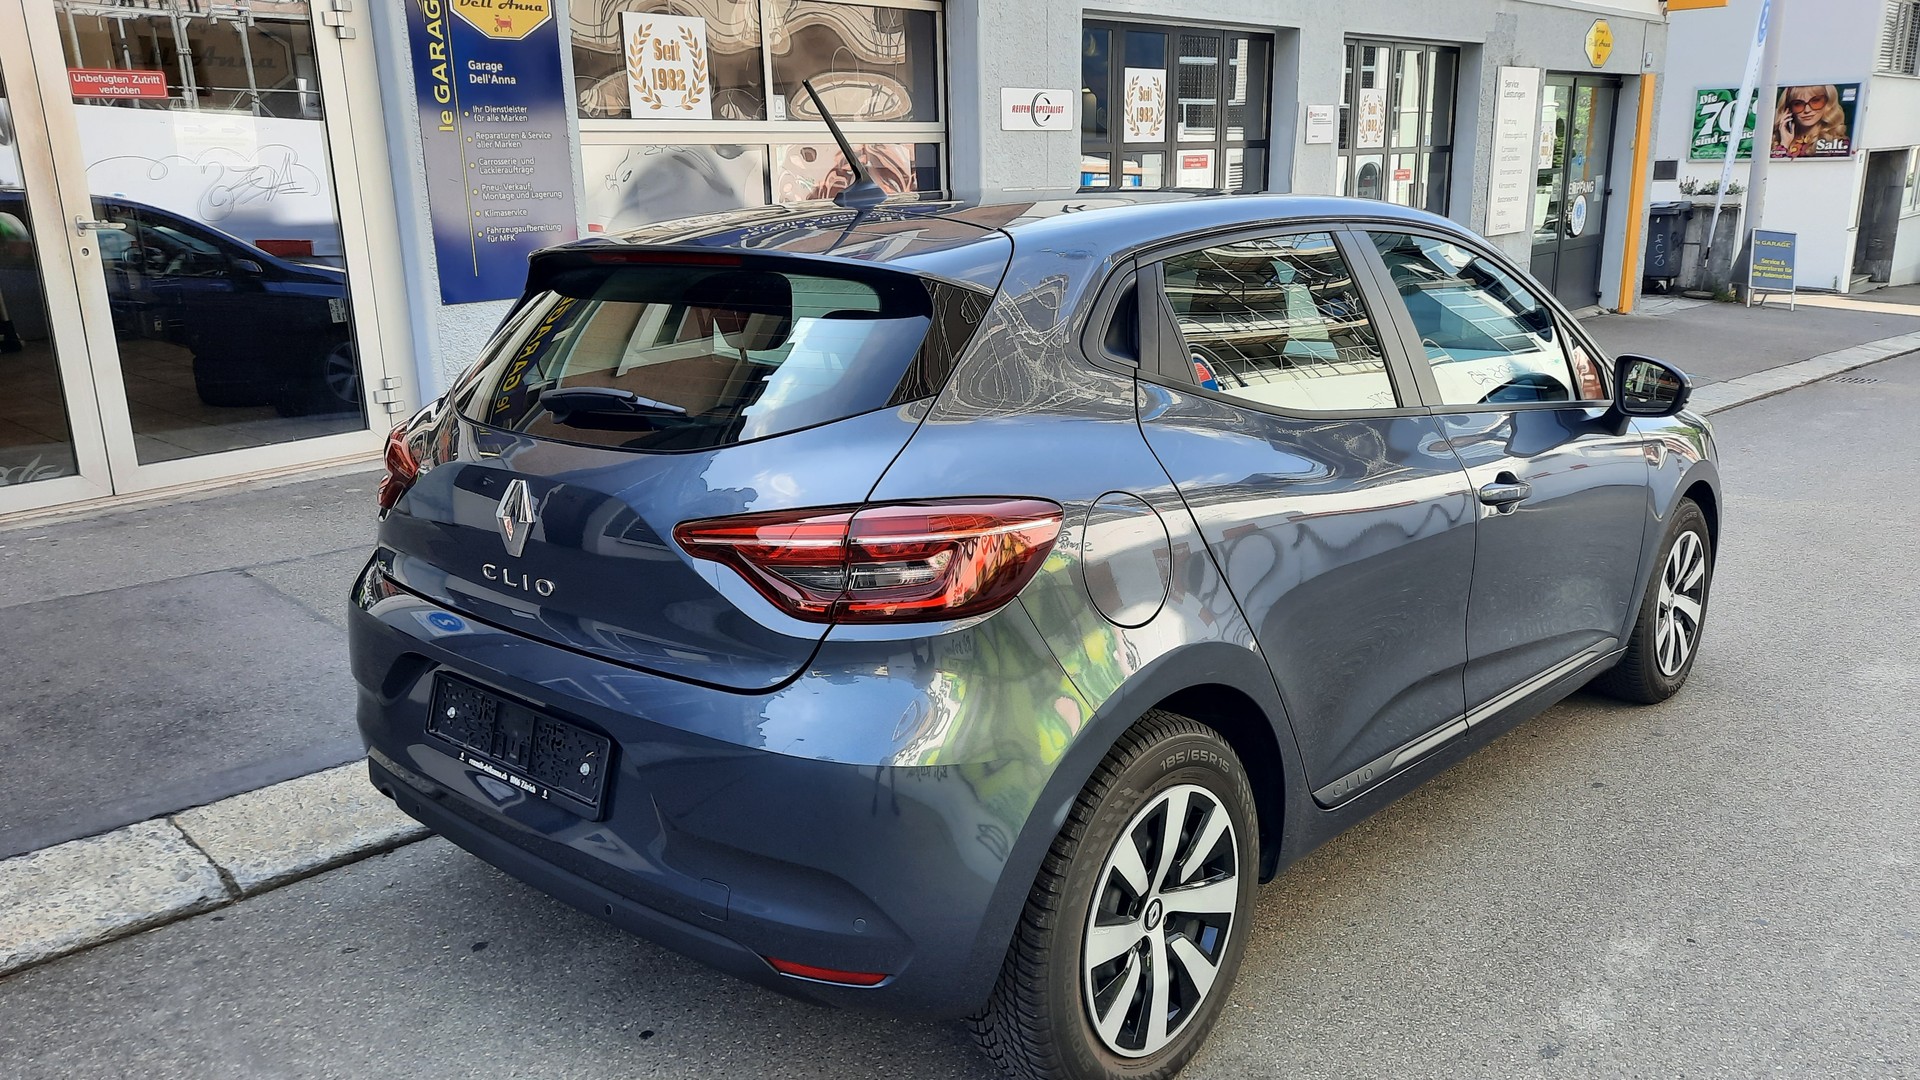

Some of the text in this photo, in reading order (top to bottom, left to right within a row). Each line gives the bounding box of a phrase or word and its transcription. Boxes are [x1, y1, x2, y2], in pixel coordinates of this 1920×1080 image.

[652, 37, 682, 62] Seit
[467, 60, 503, 73] Garage
[73, 73, 160, 84] Unbefugten Zutritt
[469, 73, 517, 85] Dell'Anna
[651, 67, 687, 91] 1982
[1504, 79, 1520, 89] Service
[99, 86, 141, 94] verboten
[1138, 85, 1153, 102] Seit
[1700, 93, 1718, 105] Die
[472, 105, 528, 113] Ihr Dienstleister
[1011, 104, 1065, 114] REIFEN SPEZIALIST
[438, 110, 454, 131] le
[474, 114, 528, 122] für alle Marken
[475, 132, 520, 141] Reparaturen
[528, 131, 552, 139] Service
[1695, 131, 1719, 147] sind
[494, 140, 522, 148] Marken
[1815, 138, 1849, 150] Salt.
[520, 157, 535, 165] und
[503, 182, 533, 191] Verkauf,
[1568, 180, 1595, 195] EMPFANG
[482, 191, 563, 202] Montage und Lagerung
[484, 209, 528, 218] Klimaservice
[486, 224, 562, 235] Fahrzeugaufbereitung
[487, 234, 516, 243] für MFK
[1761, 240, 1792, 248] GARAGE
[482, 563, 556, 597] CLIO
[1159, 748, 1230, 774] 185/65R15
[1331, 767, 1376, 798] CLIO
